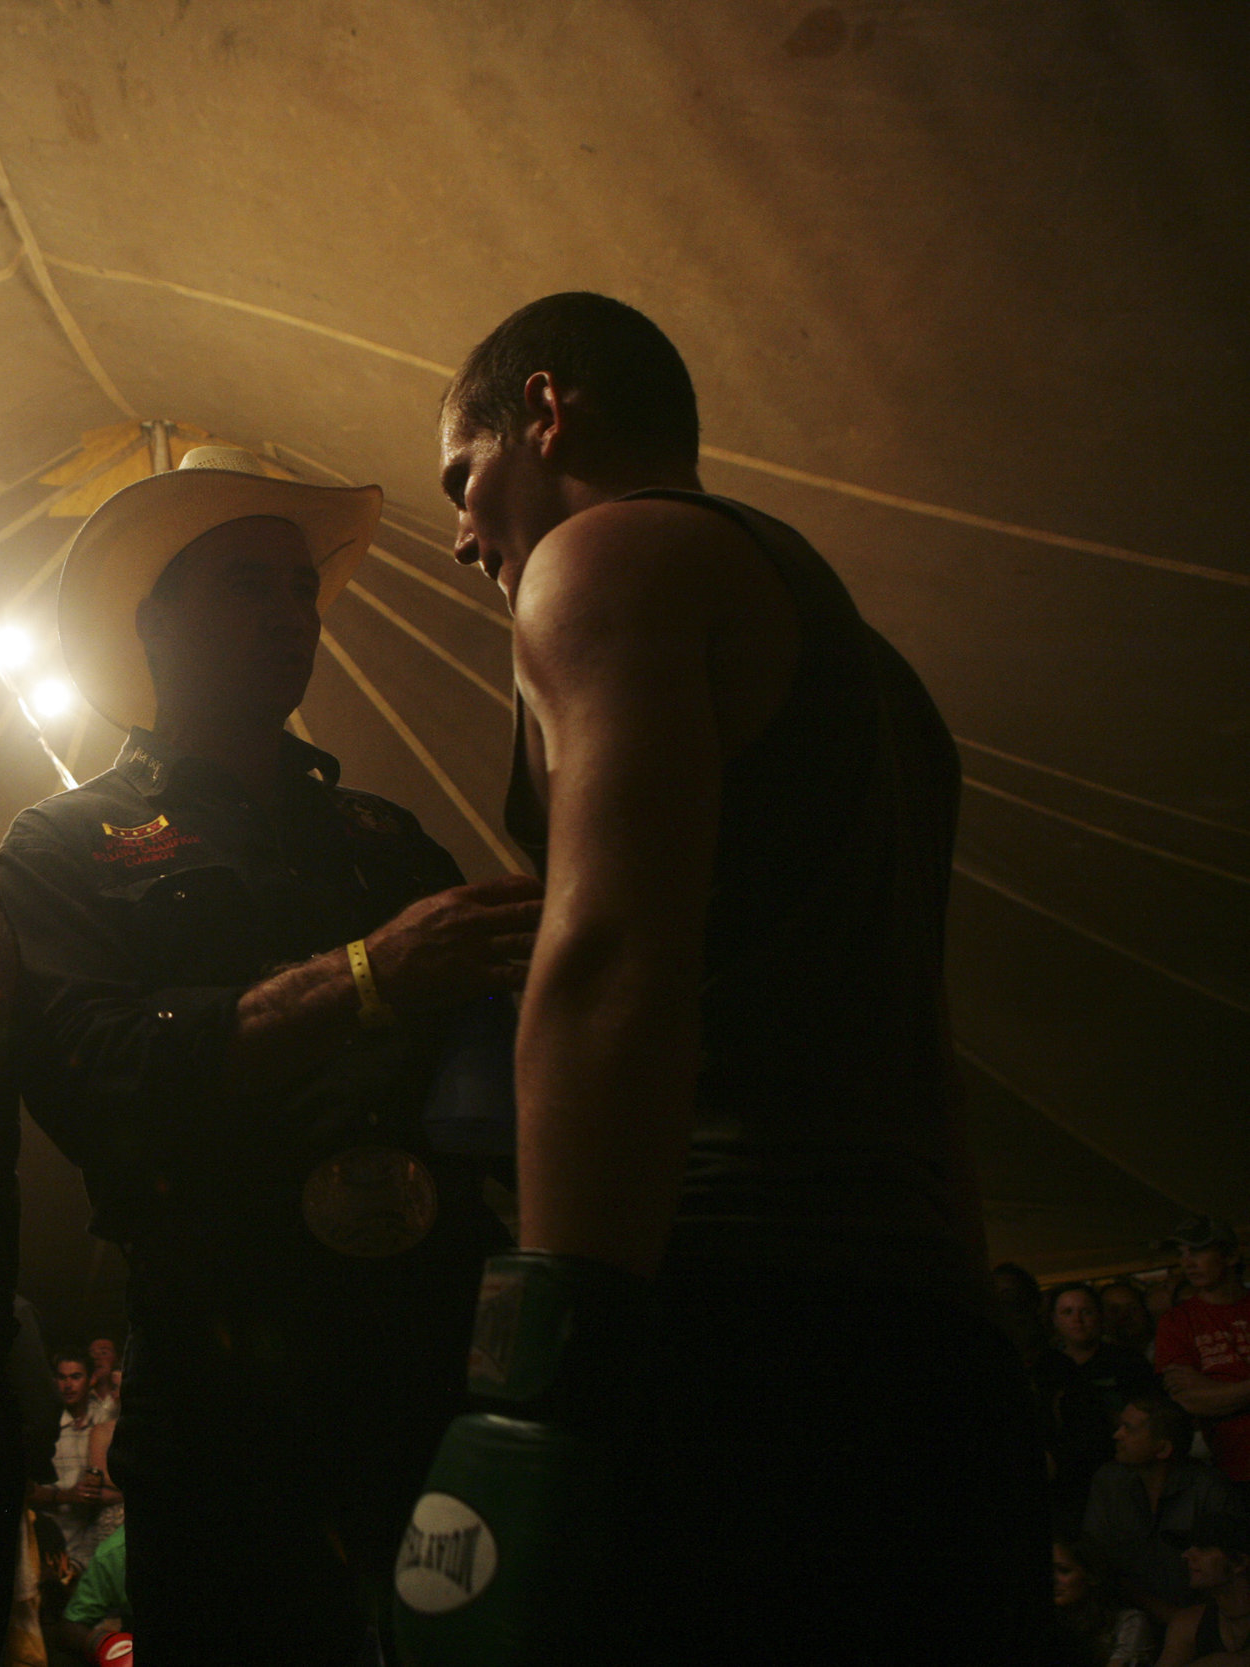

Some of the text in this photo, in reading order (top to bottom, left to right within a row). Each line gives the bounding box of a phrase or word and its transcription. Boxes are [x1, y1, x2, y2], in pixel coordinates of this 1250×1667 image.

[92, 834, 201, 862] BOXING CHAMPION
[105, 826, 179, 850] WORLD TENT
[124, 849, 176, 867] COWBOY
